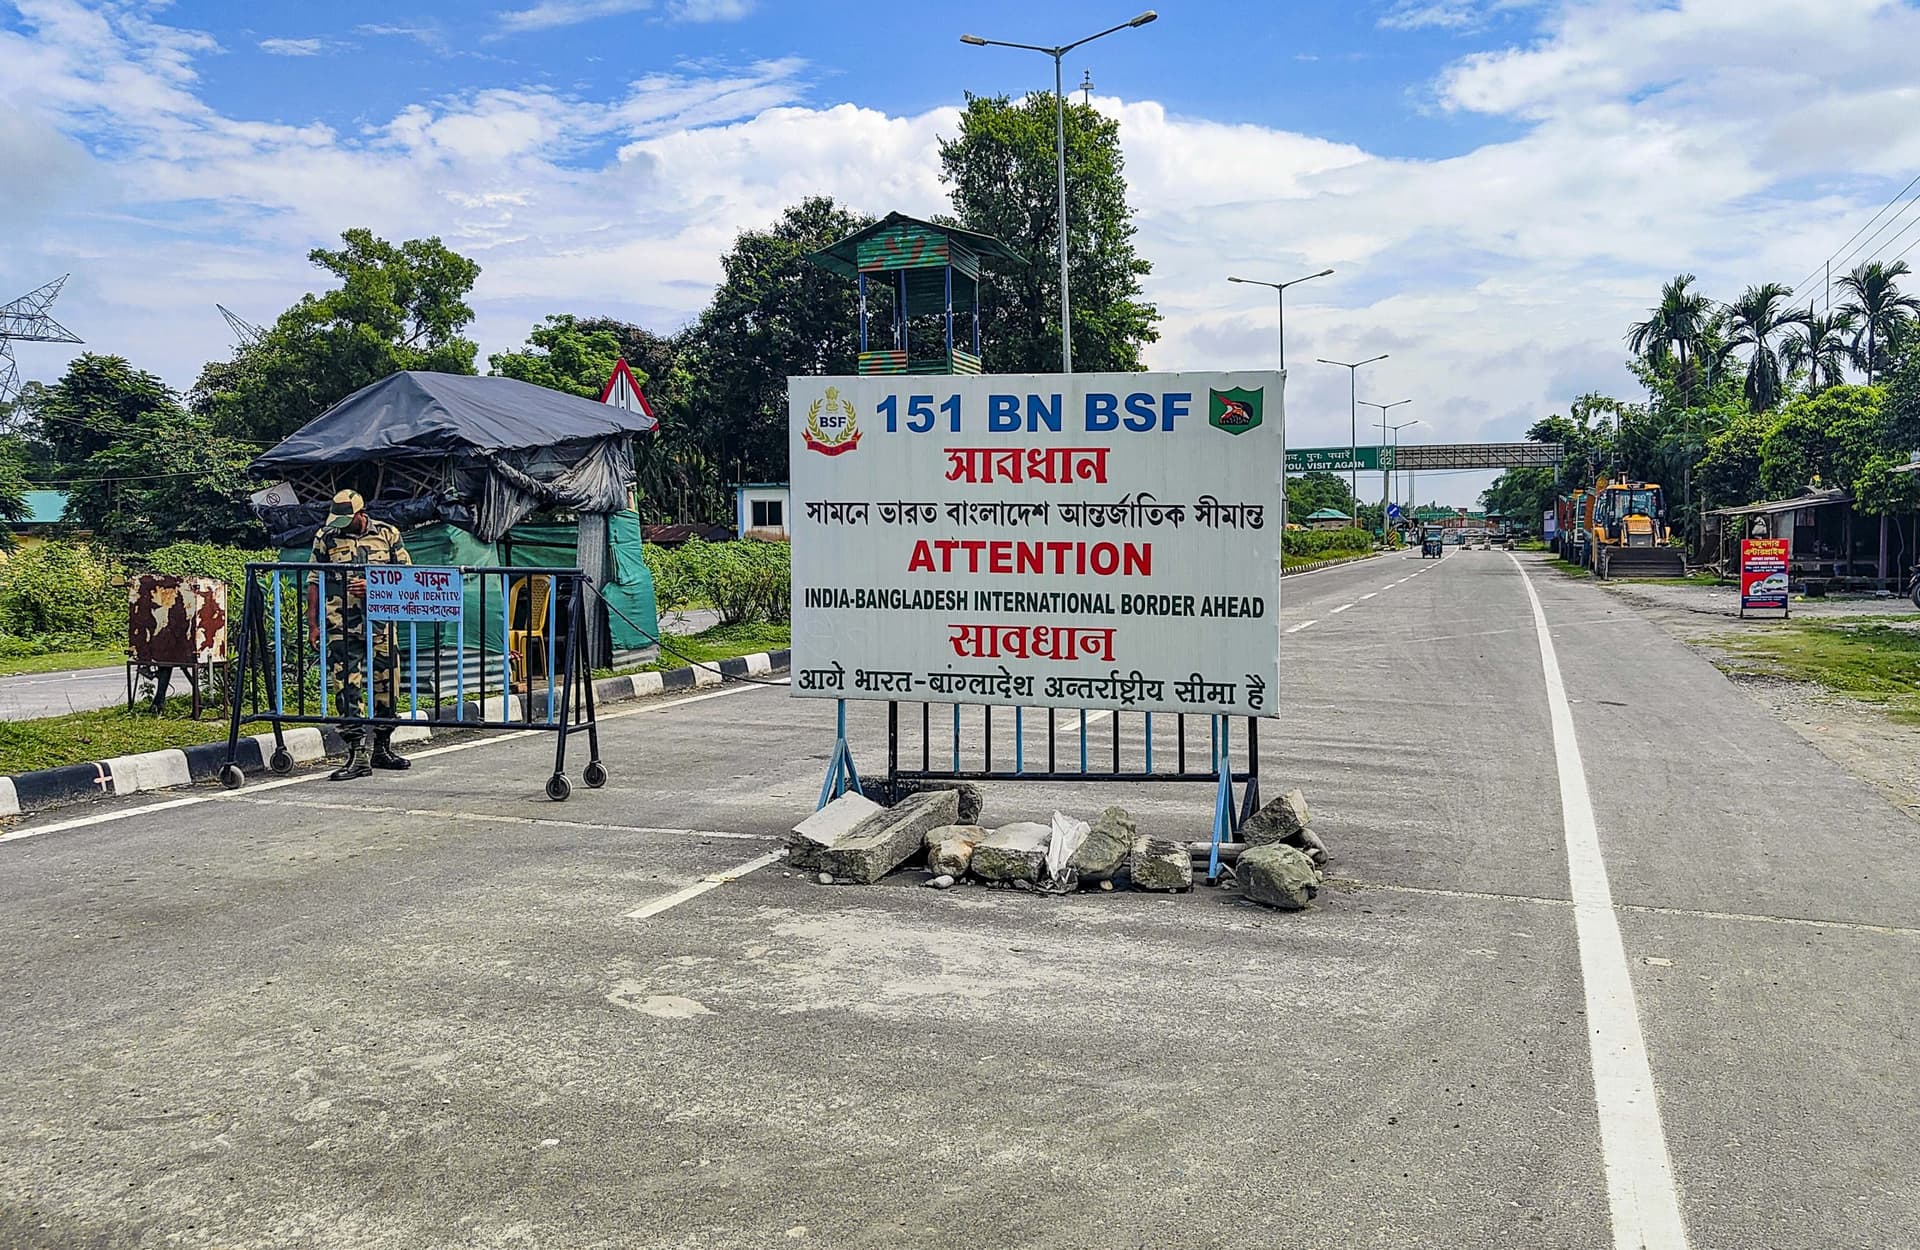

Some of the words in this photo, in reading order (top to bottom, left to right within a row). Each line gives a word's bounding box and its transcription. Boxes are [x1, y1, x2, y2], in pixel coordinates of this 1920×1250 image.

[819, 416, 847, 428] BSF
[878, 394, 960, 433] 151
[989, 394, 1062, 432] BN
[1086, 393, 1191, 431] BSF
[944, 448, 1110, 484] সাবধান
[1306, 461, 1332, 470] VISIT
[1335, 460, 1365, 469] AGAIN
[805, 499, 870, 526] সামনে
[876, 499, 937, 526] ভারত
[944, 500, 1050, 527] বাংলাদেশ
[1057, 492, 1186, 529] আন্তর্জাতিক
[1193, 495, 1265, 530] সীমান্ত
[908, 539, 1152, 577] ATTENTION
[369, 570, 402, 586] STOP
[369, 590, 393, 600] SHOW
[398, 590, 420, 601] YOUR
[805, 589, 968, 611] INDIA-BANGLADESH
[975, 591, 1115, 615] INTERNATIONAL
[1121, 594, 1195, 617] BORDER
[1201, 596, 1265, 619] AHEAD
[948, 624, 1116, 661] सावधान
[798, 661, 845, 690] आगे
[855, 664, 1034, 698] भारत-बांग्लादेश
[1045, 670, 1164, 705] अन्तर्राष्ट्रीय
[1174, 673, 1237, 704] सीमा
[1246, 674, 1266, 710] है
